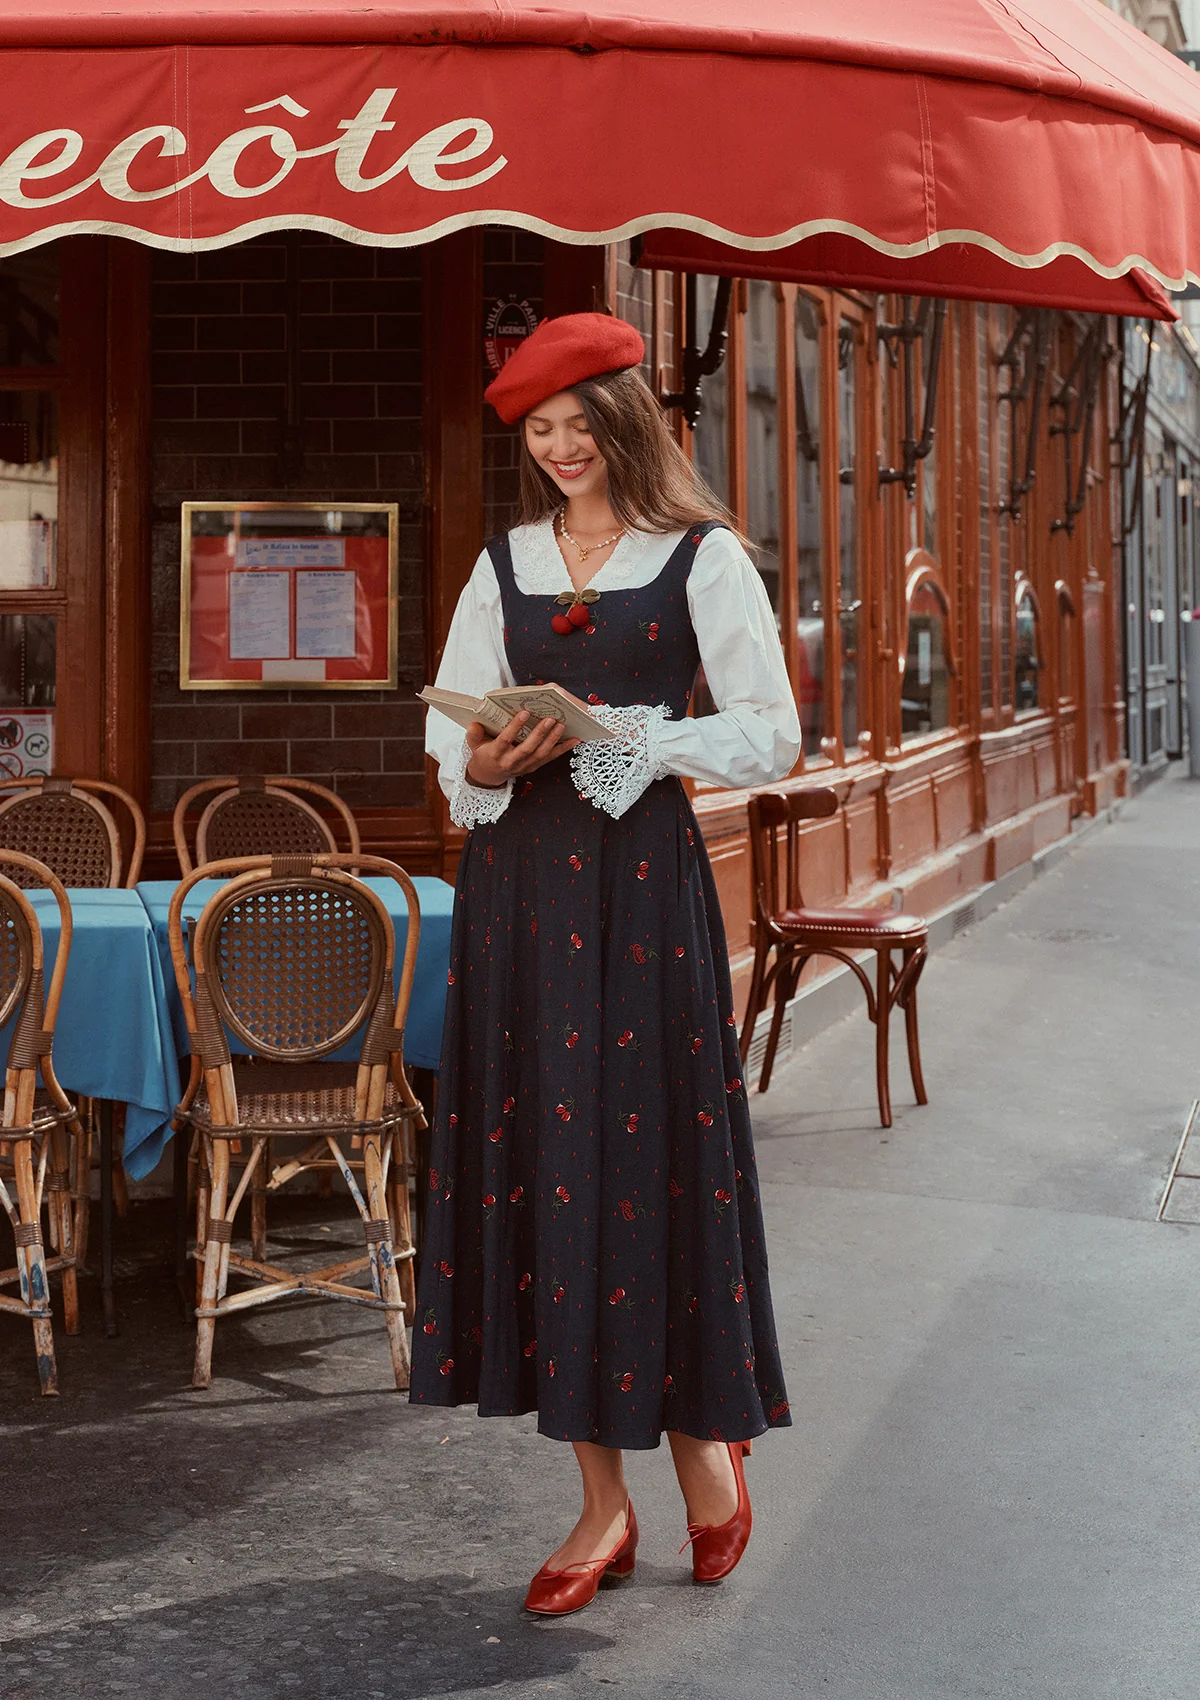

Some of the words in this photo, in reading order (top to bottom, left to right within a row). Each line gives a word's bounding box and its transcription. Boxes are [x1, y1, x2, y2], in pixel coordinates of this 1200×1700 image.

[0, 88, 508, 208] ecôte
[486, 299, 505, 330] VILLE
[498, 326, 527, 335] LICENCE
